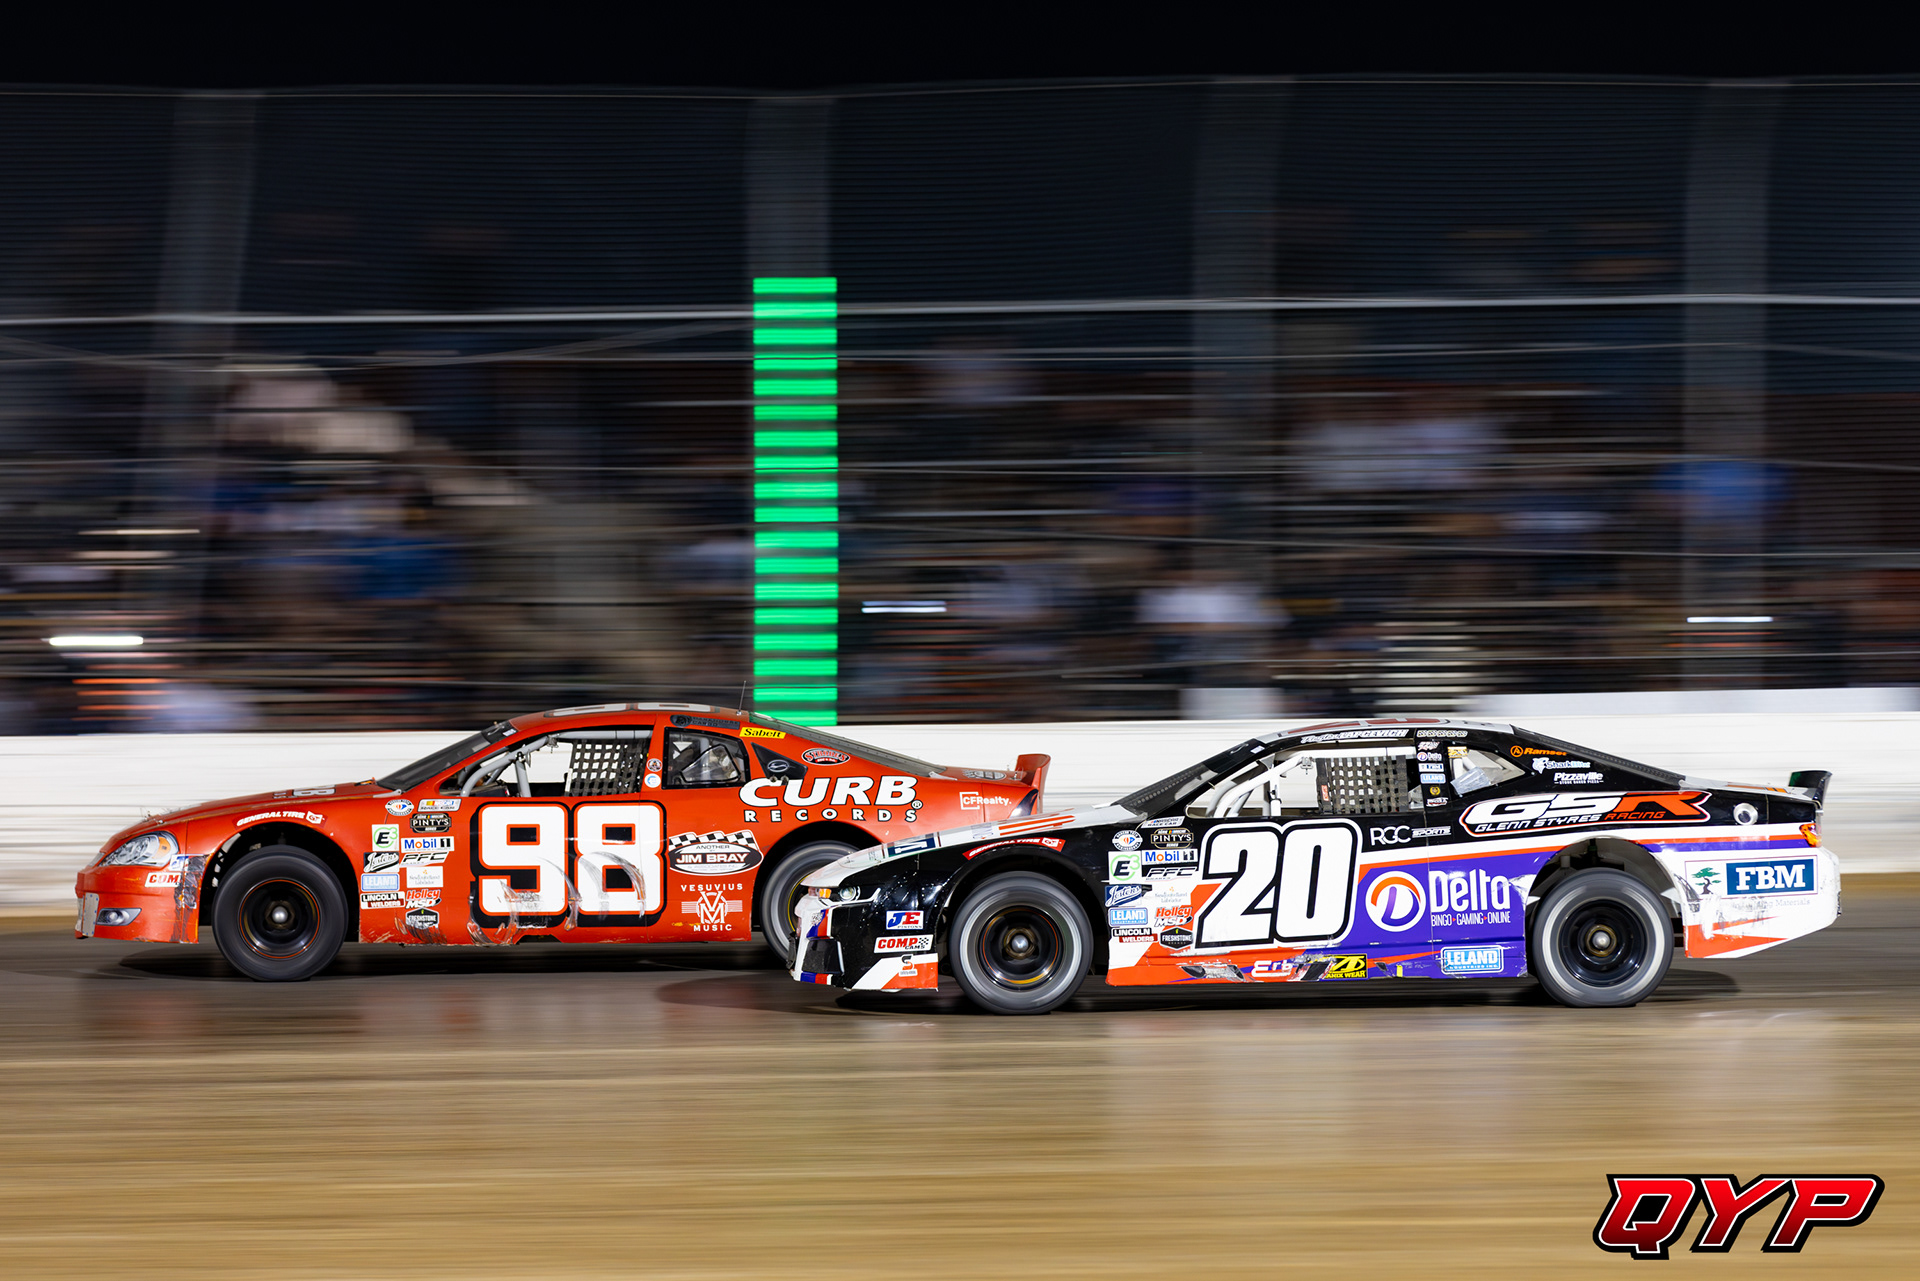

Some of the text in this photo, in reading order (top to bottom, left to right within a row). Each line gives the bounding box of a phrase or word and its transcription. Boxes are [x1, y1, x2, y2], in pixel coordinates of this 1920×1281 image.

[1554, 772, 1603, 781] Pizzaville
[739, 775, 918, 807] CURB
[1465, 791, 1703, 825] GSR
[236, 811, 305, 826] GENERAL TIRE
[744, 808, 918, 823] RECORDS
[1475, 811, 1666, 832] GLENN STYRES RACING
[412, 819, 449, 827] PINTY'S
[1153, 833, 1192, 842] PINTY'S
[1370, 825, 1411, 846] RGC
[404, 839, 436, 849] Mobil
[440, 838, 451, 847] 1
[969, 840, 1015, 857] GENERAL
[402, 852, 447, 862] PFC
[476, 803, 664, 918] 98
[676, 853, 749, 864] JIM BRAY
[1145, 851, 1179, 862] Mobil
[1147, 867, 1197, 878] PFC
[1736, 864, 1806, 891] FBM
[680, 883, 743, 891] VESUVIUS
[1196, 820, 1359, 949] 20
[362, 893, 398, 901] LINCOLN
[406, 889, 441, 900] Holley
[1429, 869, 1511, 913] Delta
[406, 900, 436, 909] MSD
[1113, 910, 1145, 920] LELAND
[1155, 906, 1192, 918] Holley
[888, 912, 921, 928] JE
[1154, 917, 1186, 927] MSD
[1431, 911, 1511, 926] BINGO GAMING ONLINE
[693, 924, 732, 932] MUSIC
[878, 937, 919, 949] COMP
[1446, 951, 1497, 965] LELAND
